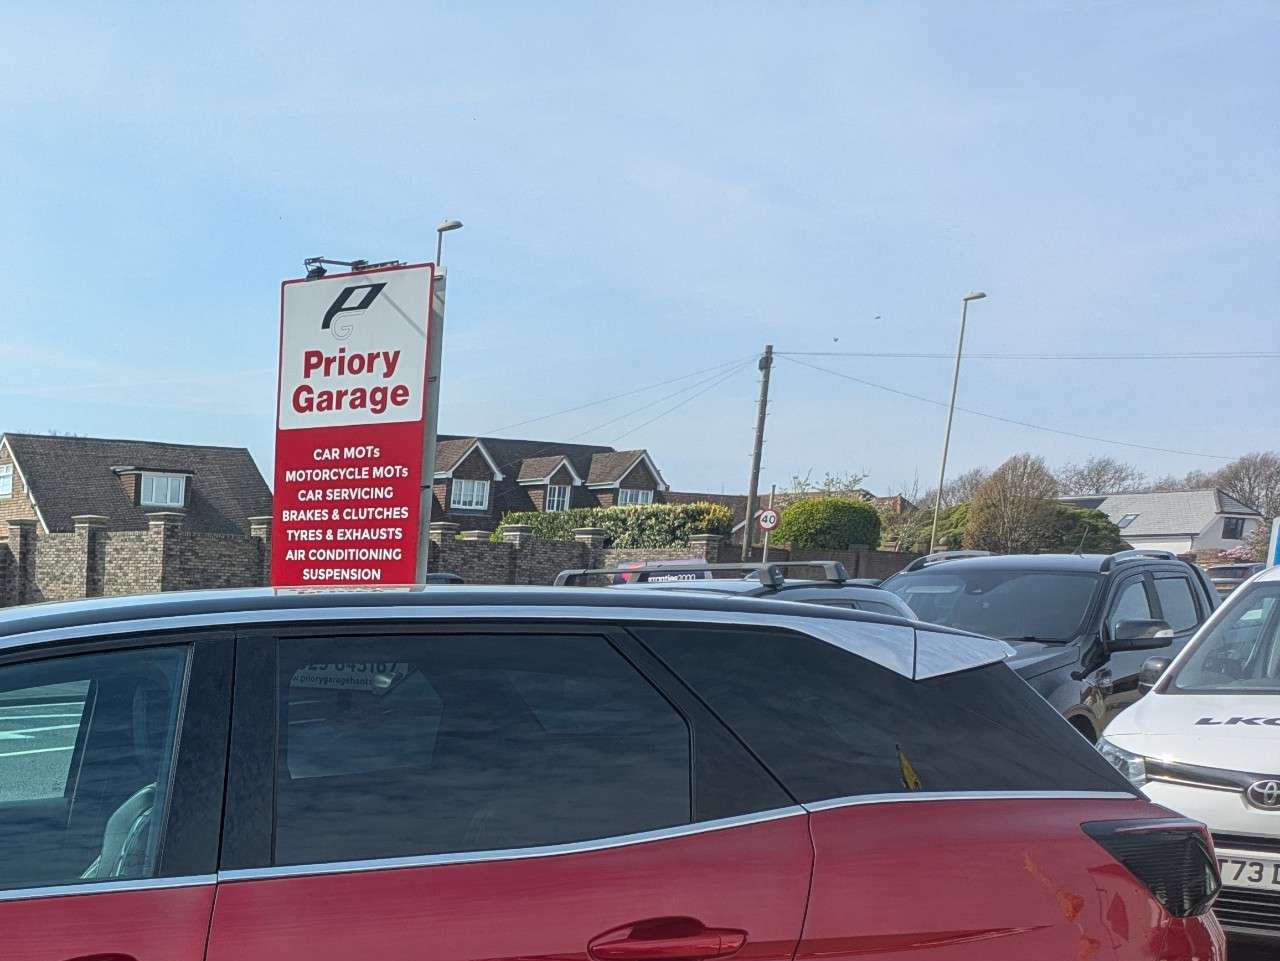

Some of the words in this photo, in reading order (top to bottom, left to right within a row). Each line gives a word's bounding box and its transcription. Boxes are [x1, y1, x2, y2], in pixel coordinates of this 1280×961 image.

[303, 347, 401, 379] Priory
[292, 384, 410, 415] Garage
[313, 448, 340, 461] CAR
[343, 446, 381, 459] MOTs
[285, 467, 370, 482] MOTORCYCLE
[372, 465, 409, 478] MOTs
[297, 489, 323, 501] CAR
[325, 486, 394, 501] SERVICING
[282, 509, 329, 521] BRAKES
[331, 508, 340, 520] &
[343, 506, 409, 520] CLUTCHES
[761, 515, 776, 524] 40
[286, 529, 323, 541] TYRES
[325, 528, 334, 540] &
[337, 527, 403, 540] EXHAUSTS
[285, 549, 306, 561] AIR
[308, 548, 402, 561] CONDITIONING
[302, 568, 381, 580] SUSPENSION
